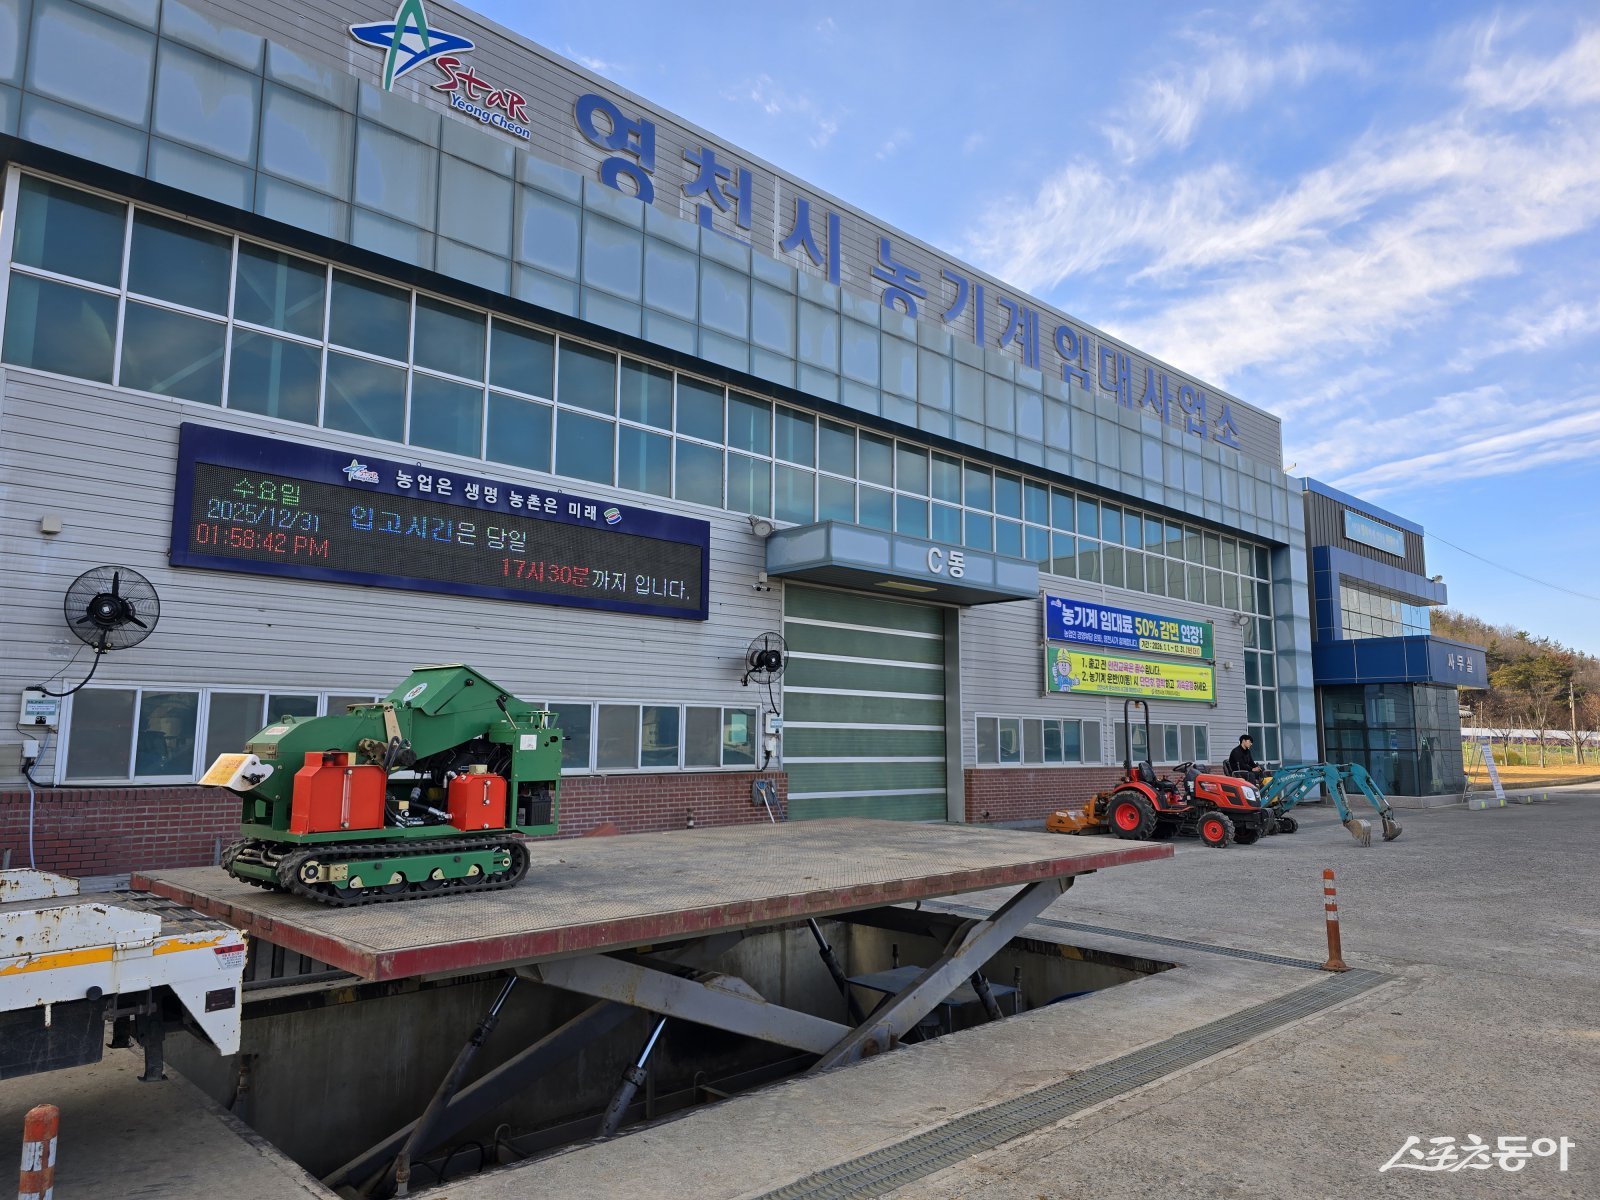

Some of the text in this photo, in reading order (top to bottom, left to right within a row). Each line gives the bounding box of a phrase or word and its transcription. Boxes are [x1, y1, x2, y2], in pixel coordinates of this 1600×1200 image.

[233, 477, 300, 506] 수요일
[396, 470, 597, 521] 농업은 생명 농촌은 미래
[207, 498, 320, 532] 2025/12/31
[351, 504, 527, 553] 입고시간은 당일
[196, 523, 329, 558] 01:58:42 PM
[635, 573, 690, 600] 입니다.
[1061, 603, 1203, 645] 농기계 임대료 50% 감면 연장!
[1082, 658, 1087, 668] 1.
[1089, 658, 1100, 670] 출고
[1082, 671, 1089, 682] 2.
[1089, 672, 1106, 683] 농기계
